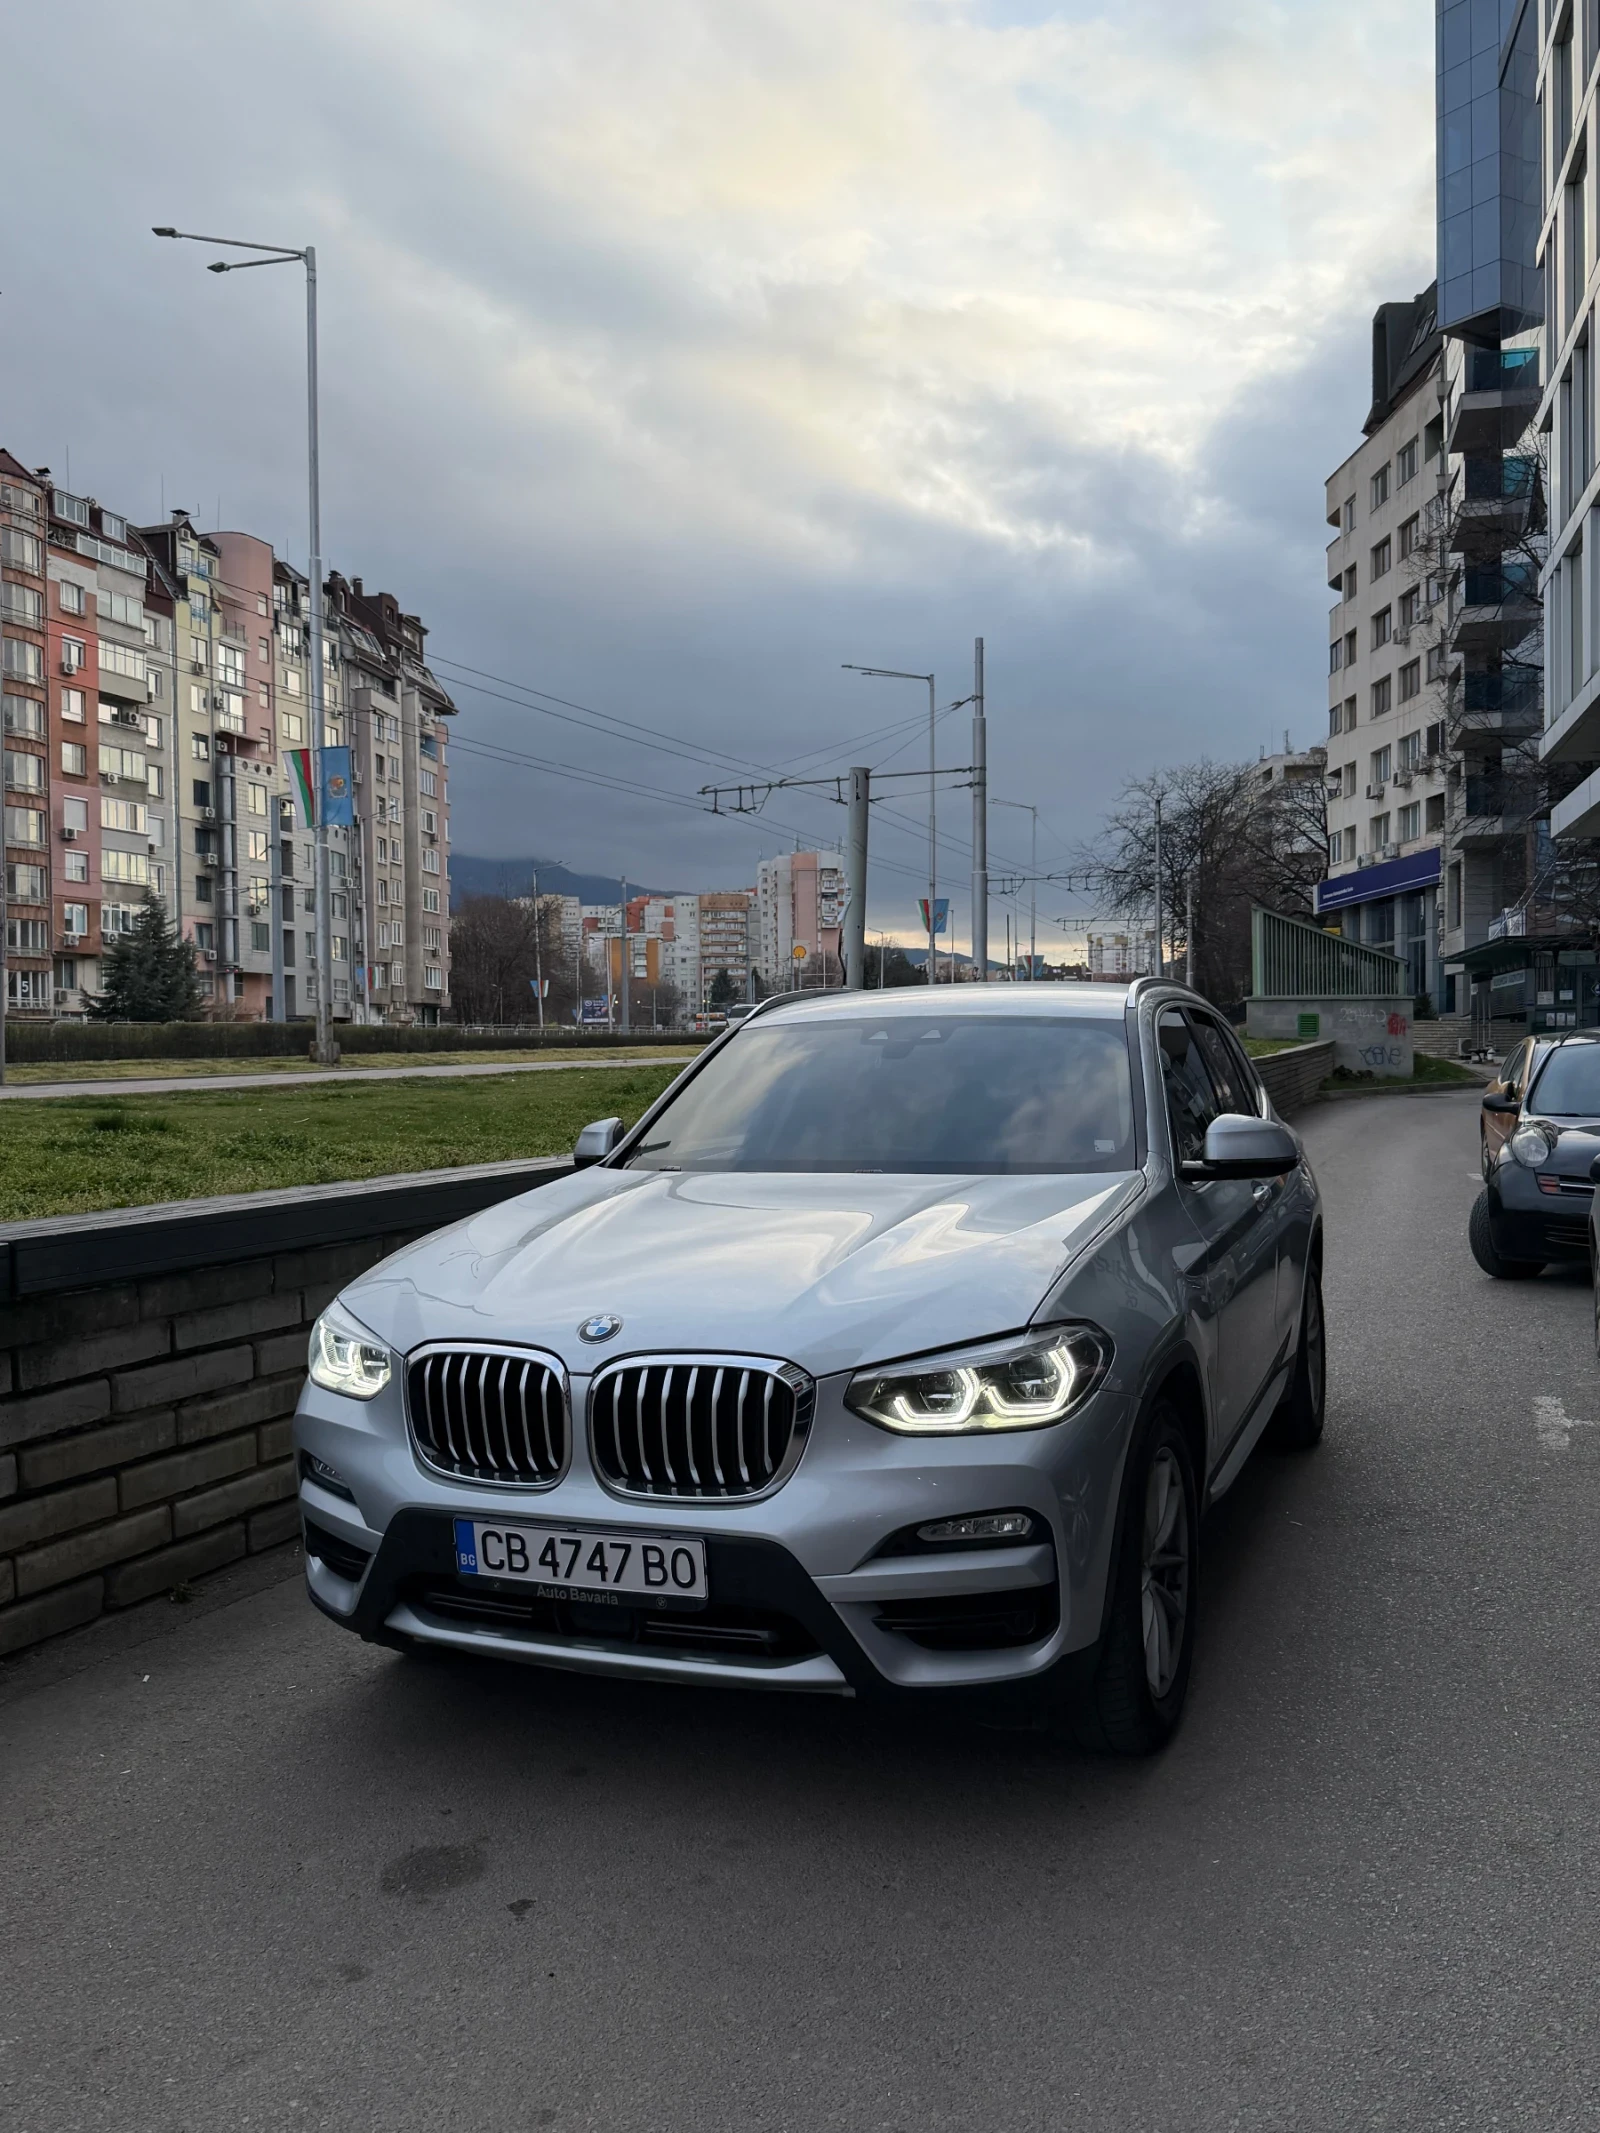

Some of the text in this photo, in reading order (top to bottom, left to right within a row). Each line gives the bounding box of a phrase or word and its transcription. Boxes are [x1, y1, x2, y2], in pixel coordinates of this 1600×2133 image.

[22, 980, 29, 993] 5
[461, 1553, 475, 1566] BG
[481, 1530, 696, 1588] CB 4747 BO
[537, 1585, 618, 1605] Auto Bavaria
